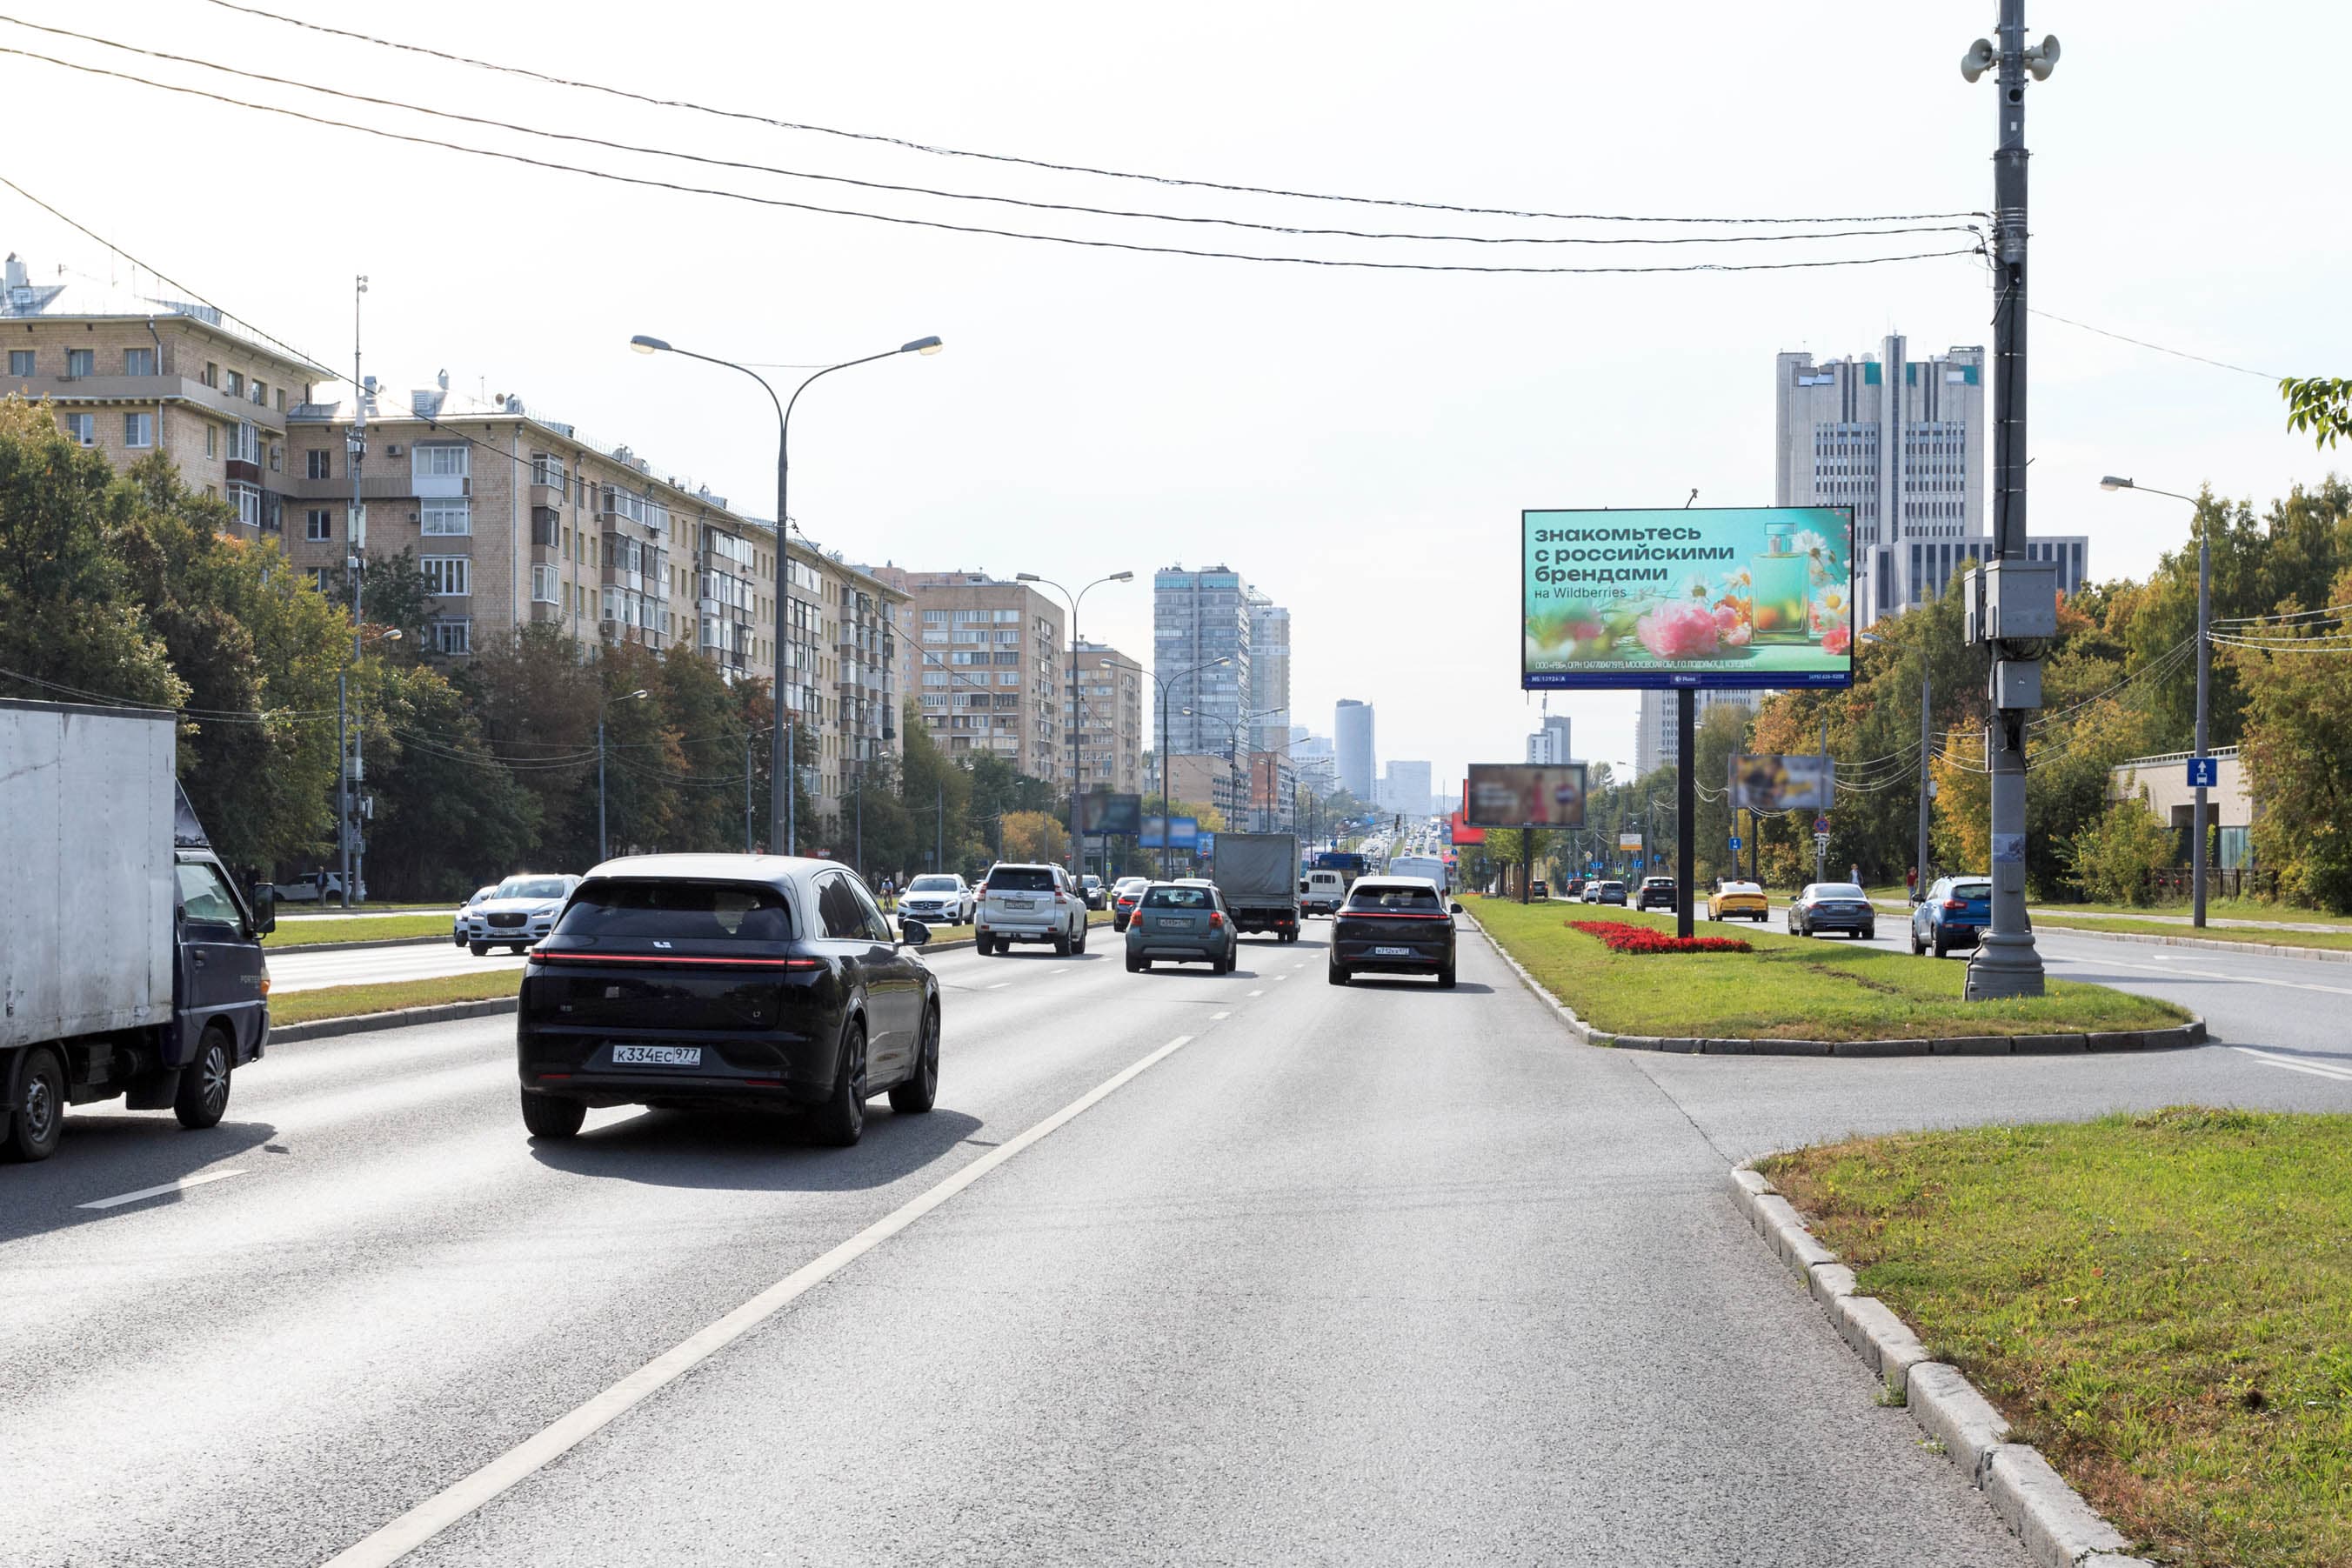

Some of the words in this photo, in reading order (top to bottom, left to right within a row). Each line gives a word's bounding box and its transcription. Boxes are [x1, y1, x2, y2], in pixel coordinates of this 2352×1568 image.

[1534, 527, 1702, 543] знакомьтесь
[1534, 549, 1550, 563] с
[1554, 544, 1735, 565] российскими
[1534, 565, 1668, 585] брендами
[1534, 589, 1550, 599] на
[1553, 587, 1627, 599] Wildberries
[618, 1047, 673, 1063] К334ЕС
[675, 1048, 698, 1060] 977
